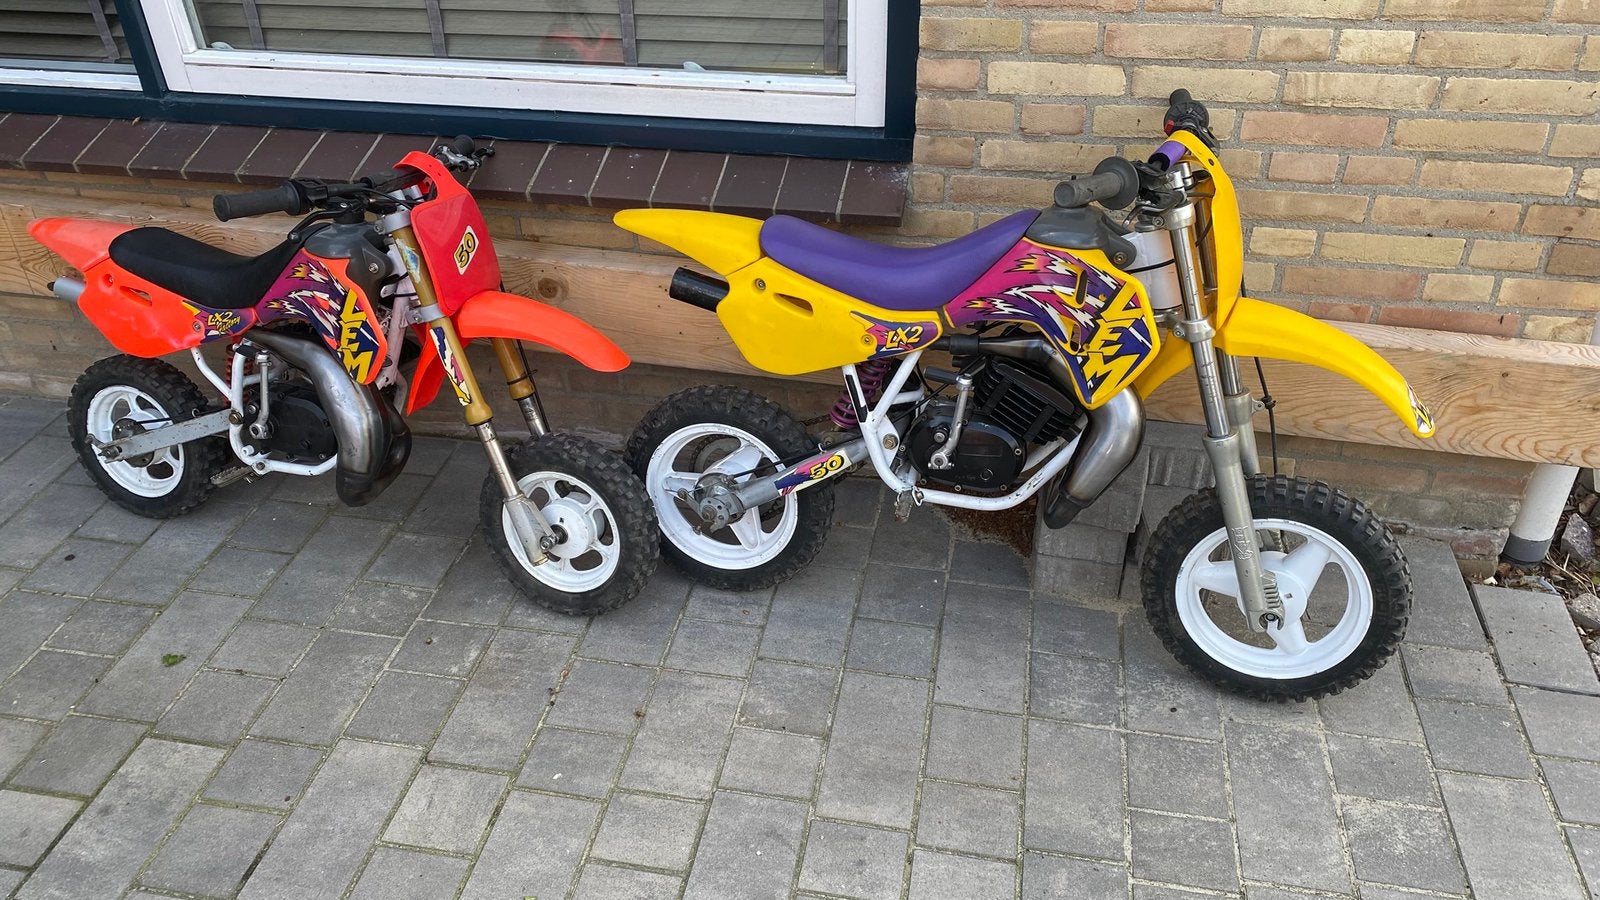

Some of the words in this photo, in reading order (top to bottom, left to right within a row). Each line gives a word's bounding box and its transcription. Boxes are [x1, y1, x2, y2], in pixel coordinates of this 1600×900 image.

[454, 232, 475, 268] 50
[207, 311, 233, 326] LX2
[886, 326, 924, 348] LX2
[810, 454, 844, 480] 50
